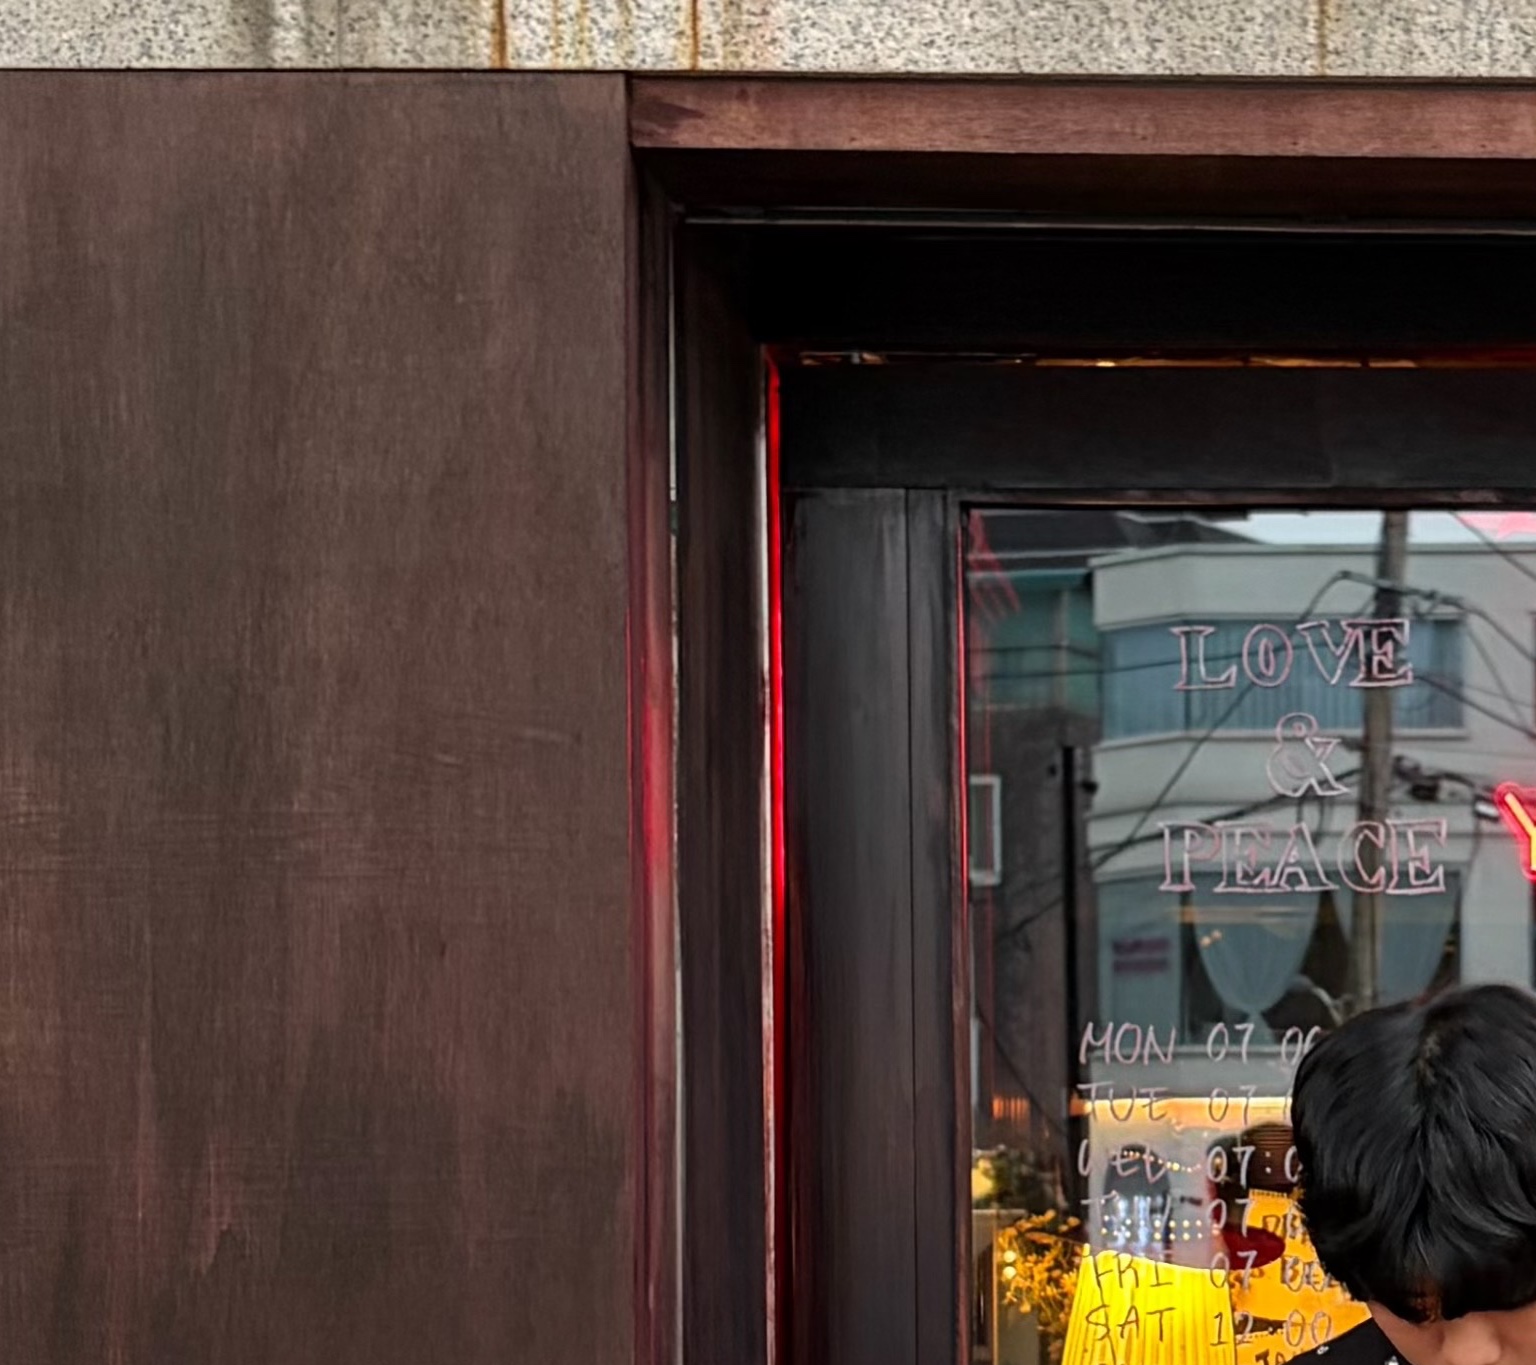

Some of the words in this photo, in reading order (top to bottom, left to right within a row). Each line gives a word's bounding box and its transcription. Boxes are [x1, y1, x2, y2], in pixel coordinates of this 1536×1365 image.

[1171, 620, 1413, 690] LOVE
[1266, 713, 1351, 798] &
[1157, 817, 1450, 894] PEACE
[1079, 1022, 1177, 1065] MON
[1085, 1304, 1176, 1341] SAT
